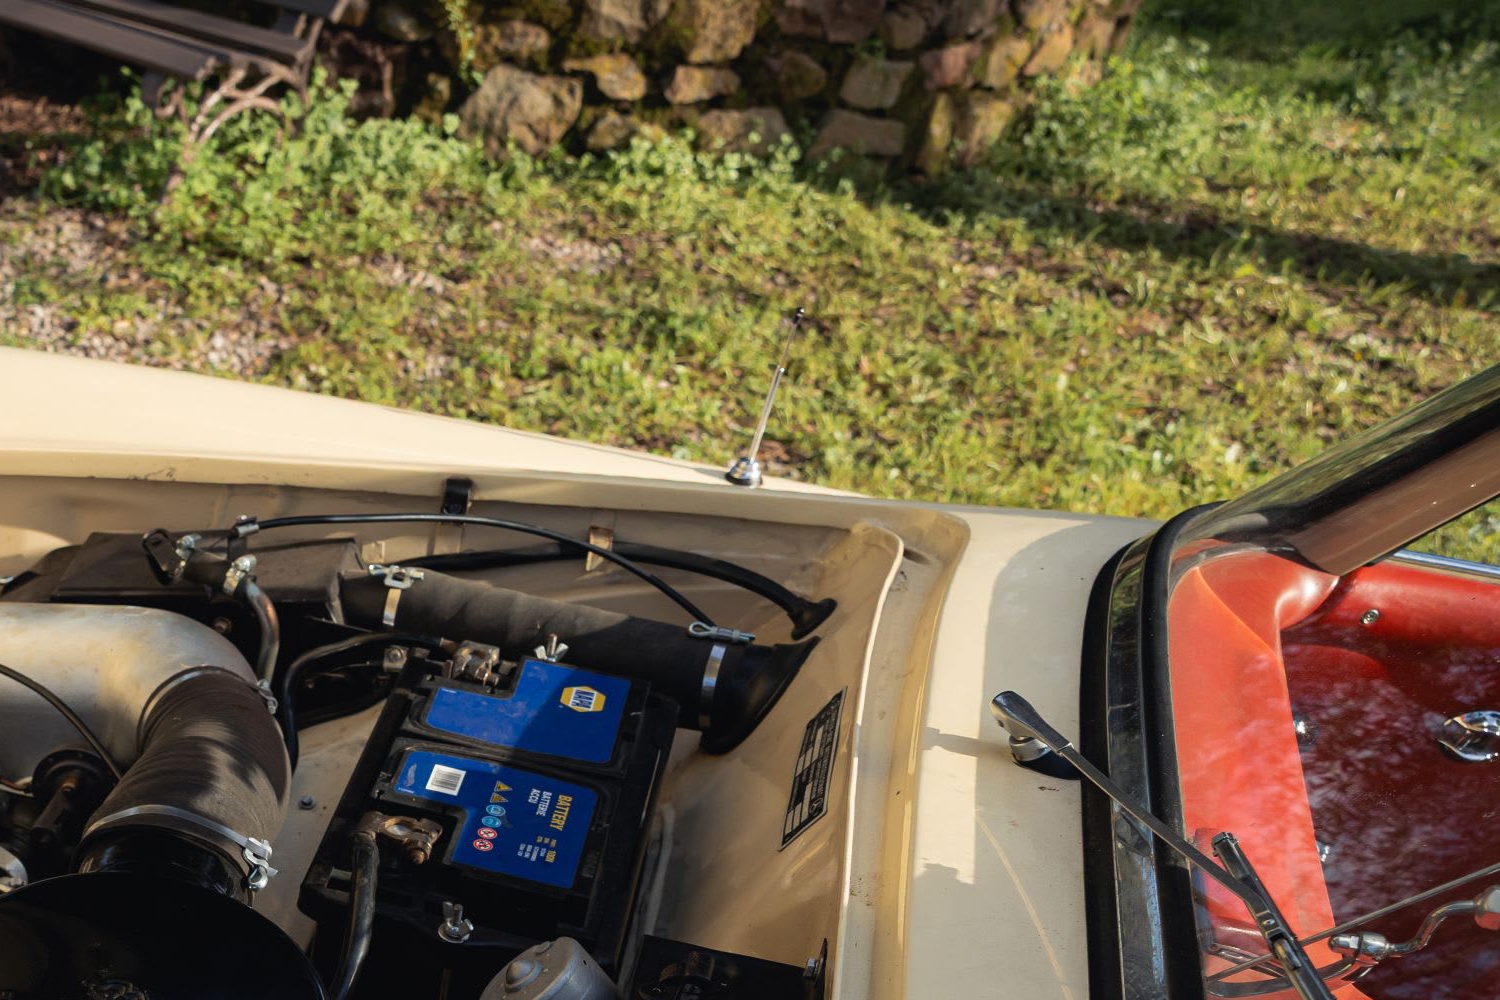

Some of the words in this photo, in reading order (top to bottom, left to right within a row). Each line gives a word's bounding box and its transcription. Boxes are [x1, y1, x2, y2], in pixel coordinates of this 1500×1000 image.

[571, 689, 596, 709] NAPA
[527, 788, 541, 804] ACCU
[536, 790, 553, 817] BATTERIE
[549, 794, 573, 832] BATTERY
